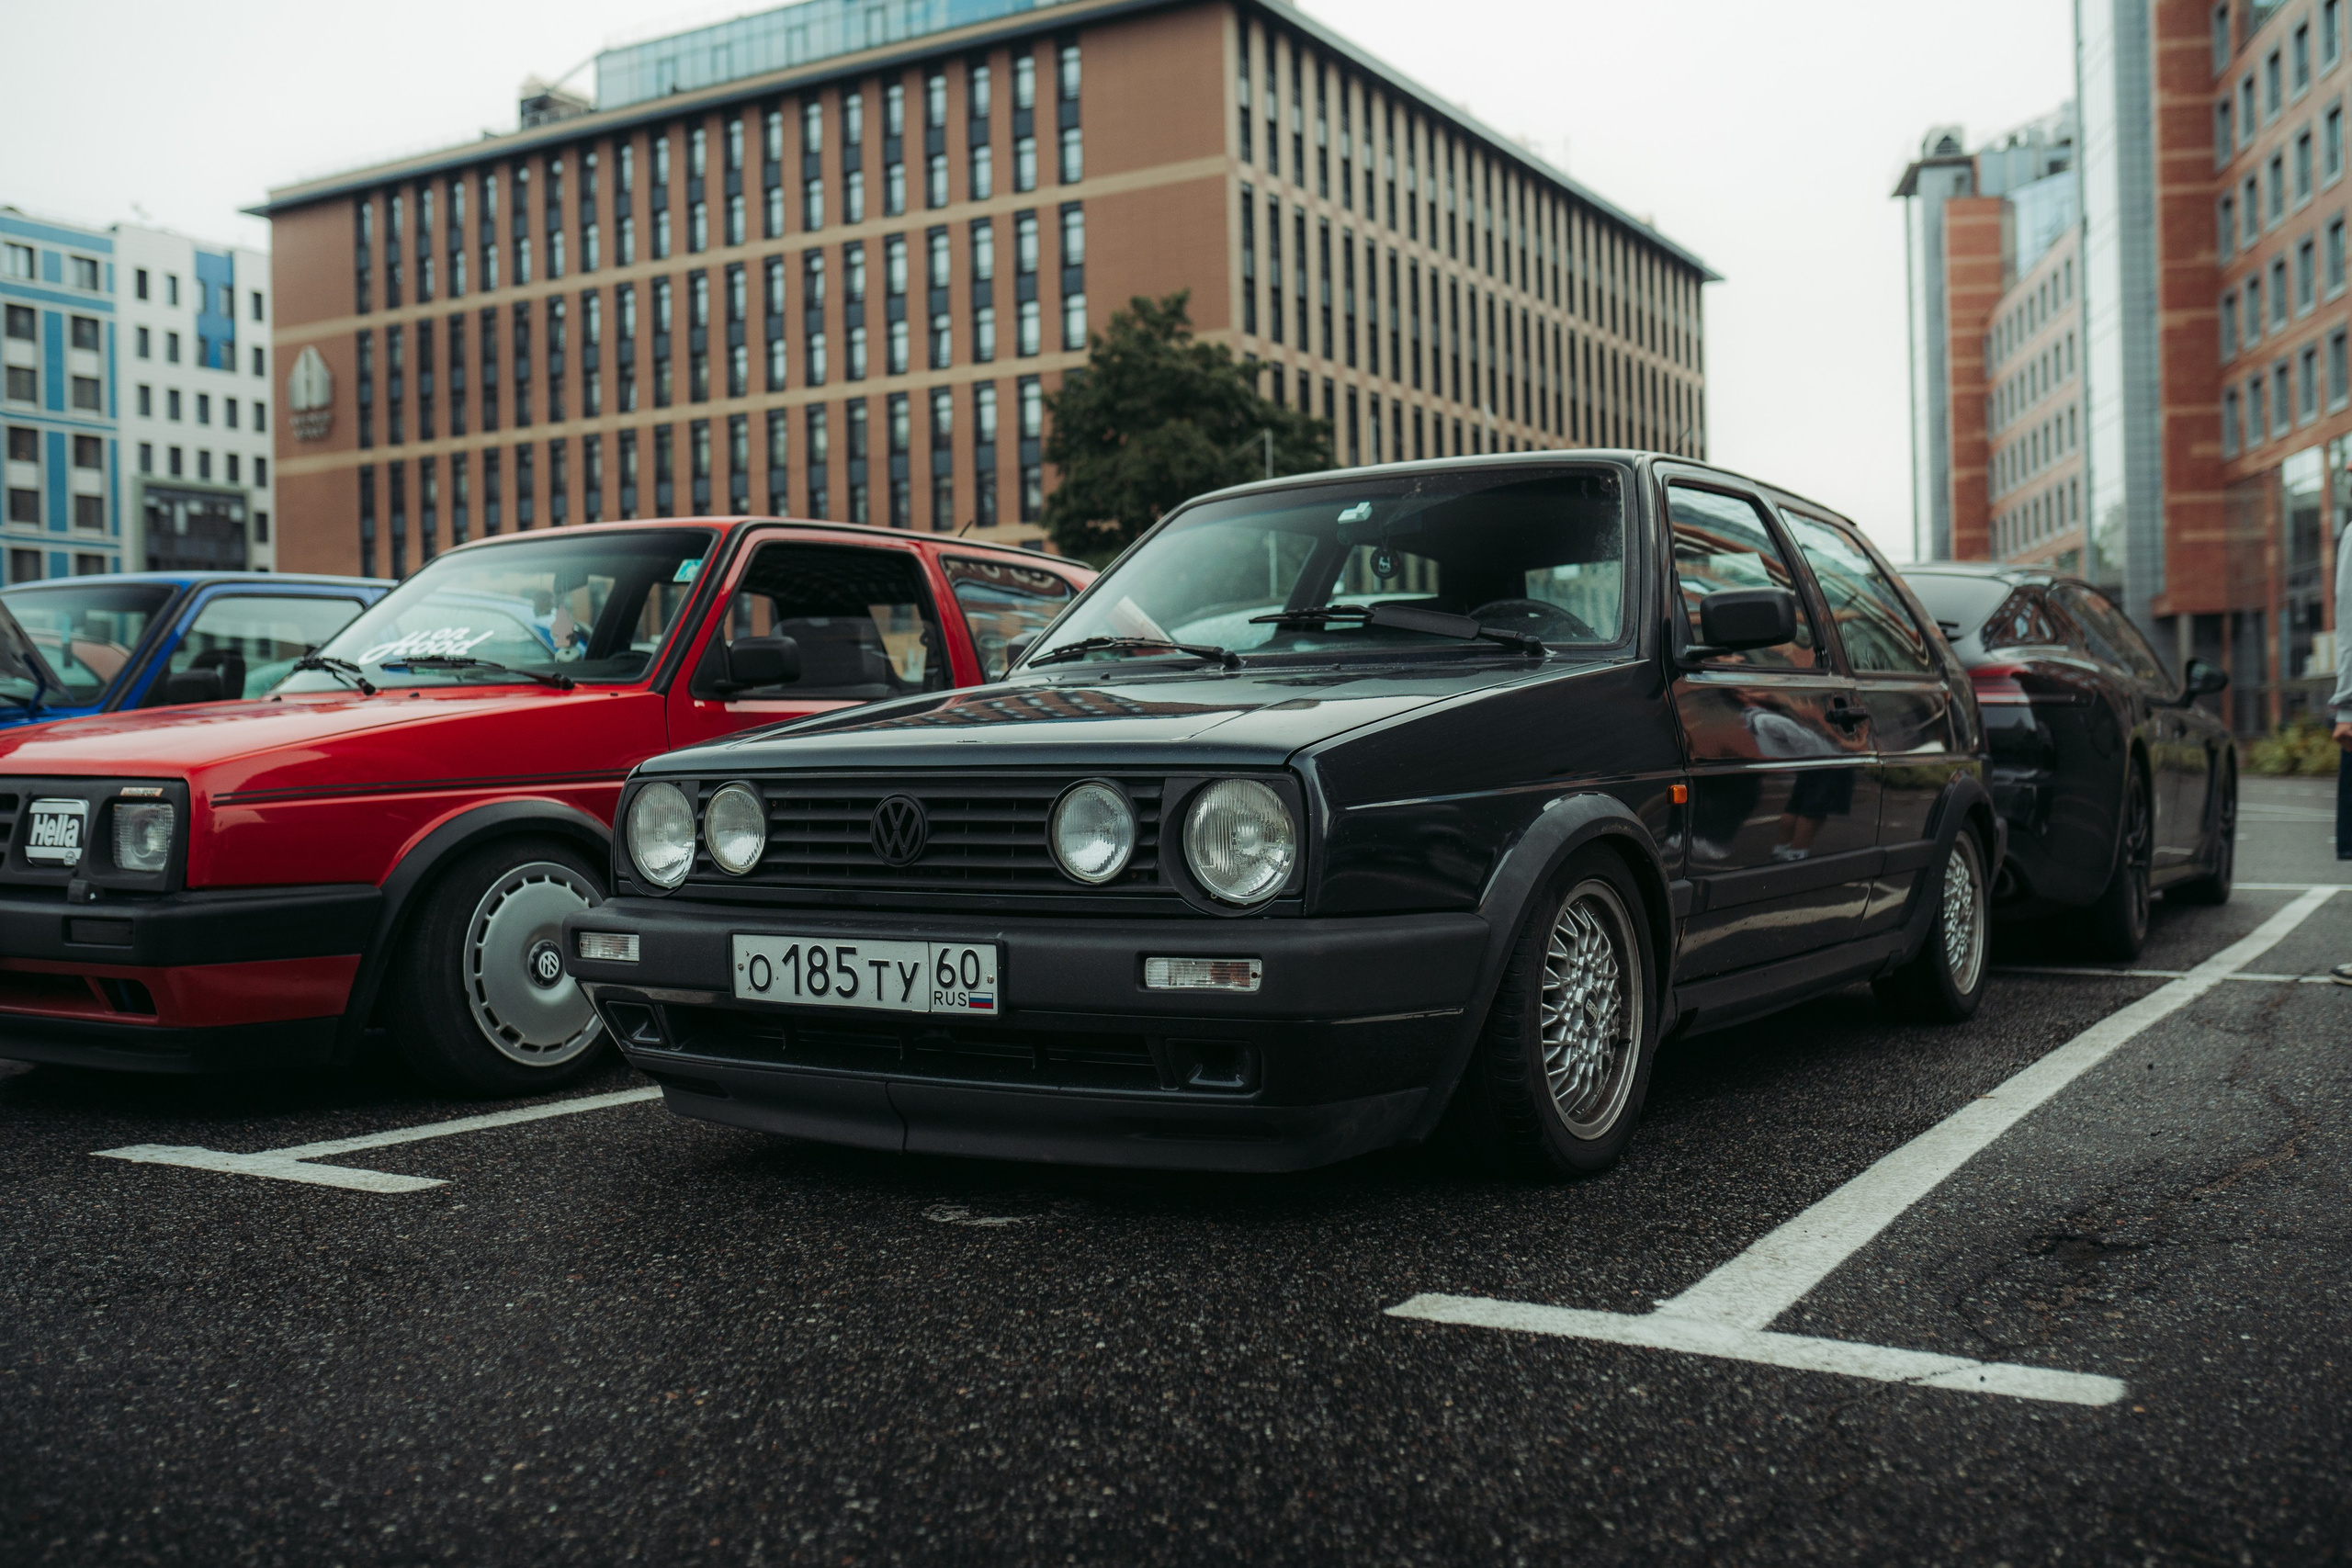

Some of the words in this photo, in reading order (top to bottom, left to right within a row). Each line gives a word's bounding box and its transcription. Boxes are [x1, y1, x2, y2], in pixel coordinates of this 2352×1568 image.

[29, 813, 80, 848] Hella
[935, 947, 981, 990] 60
[933, 990, 967, 1007] RUS
